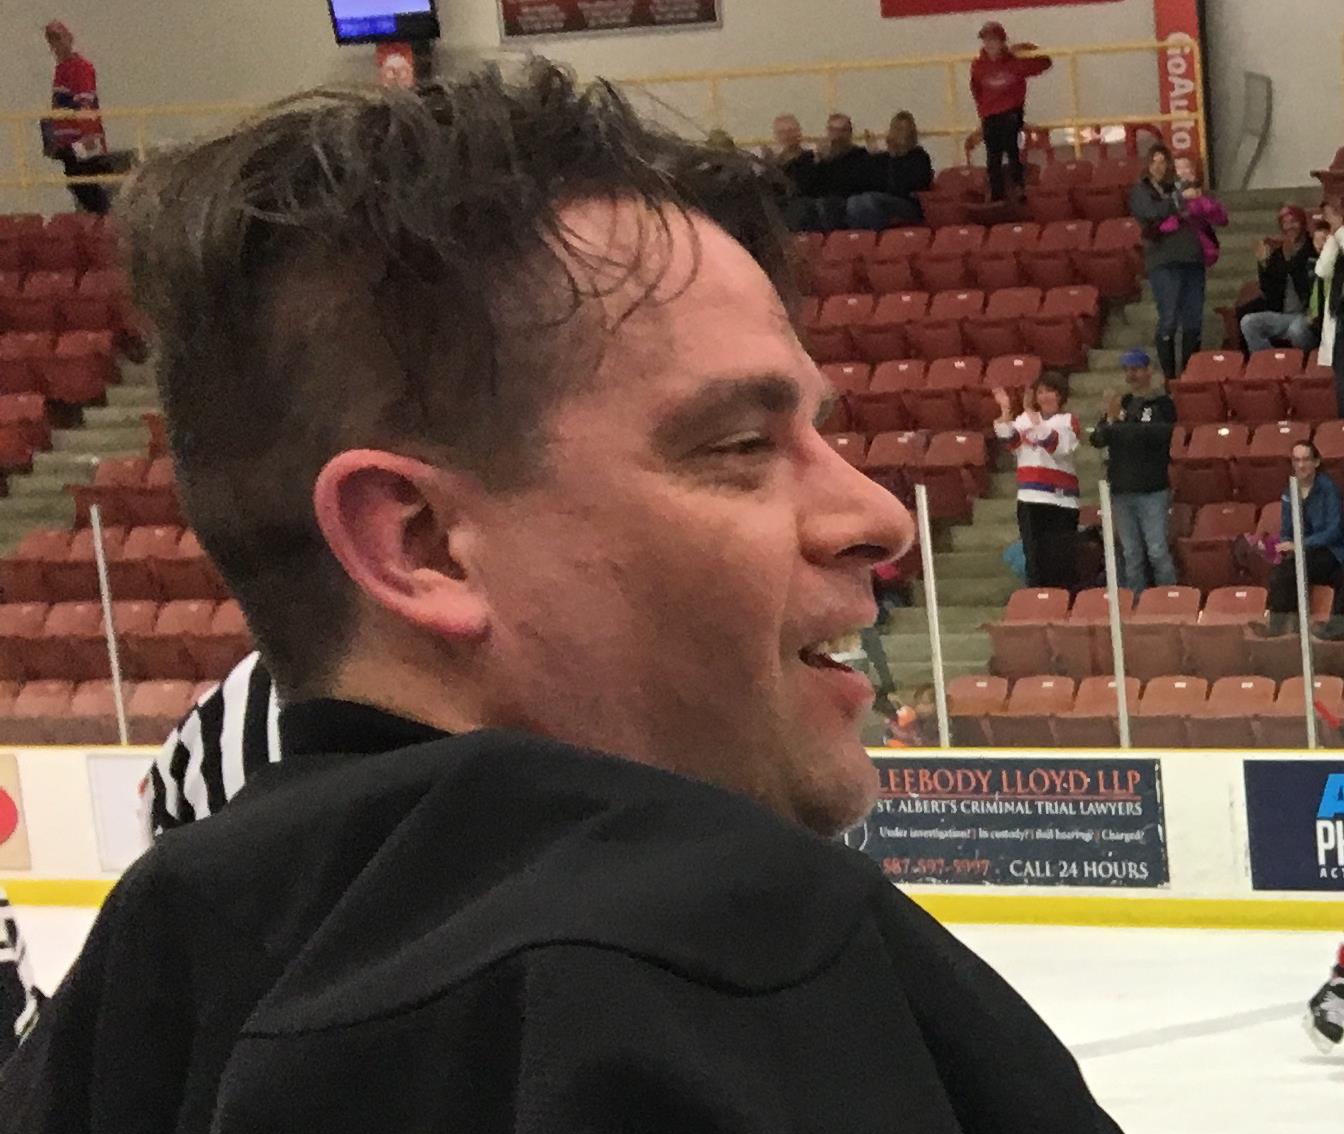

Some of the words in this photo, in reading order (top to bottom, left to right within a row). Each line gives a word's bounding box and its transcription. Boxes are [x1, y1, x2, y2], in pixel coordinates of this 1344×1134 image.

[1002, 768, 1088, 793] LLOYD
[1099, 768, 1141, 794] LLP
[898, 800, 957, 814] ALBERT'S
[961, 801, 1032, 815] CRIMINAL
[1035, 801, 1076, 815] TRIAL
[1080, 801, 1142, 816] LAWYERS
[1009, 859, 1054, 878] CALL
[1058, 860, 1078, 878] 24
[1084, 860, 1149, 879] HOURS
